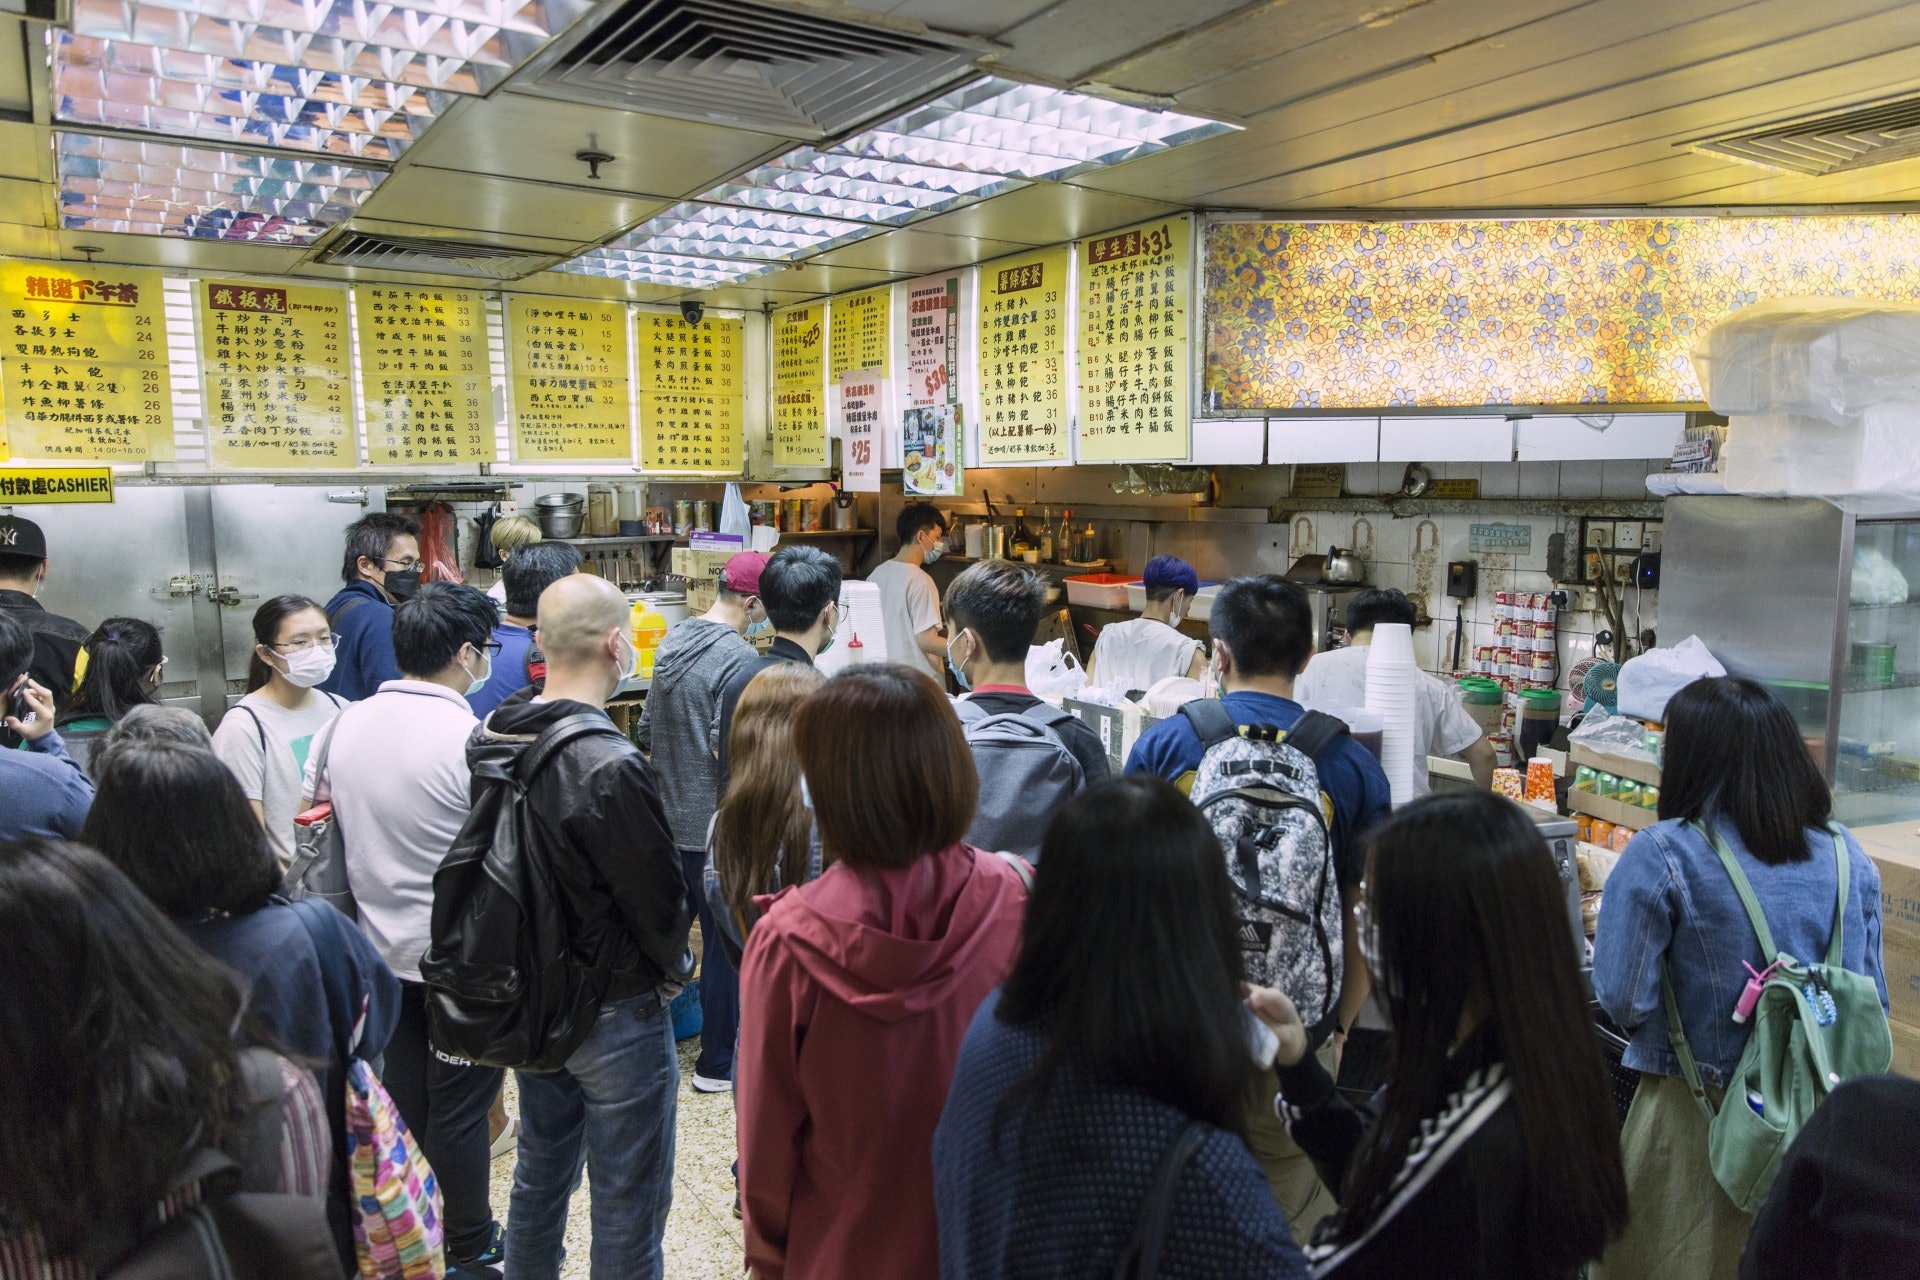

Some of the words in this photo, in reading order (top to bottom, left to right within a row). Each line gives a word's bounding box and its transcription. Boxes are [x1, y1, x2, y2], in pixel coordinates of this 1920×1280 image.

[1095, 233, 1137, 260] 學生餐
[1141, 224, 1173, 257] $31
[999, 265, 1041, 291] 薯條套餐
[26, 276, 139, 304] 精選下午茶
[214, 288, 286, 312] 鐵板燒
[456, 293, 469, 302] 33
[983, 305, 989, 313] A
[994, 296, 1028, 312] 炸豬扒
[1045, 291, 1057, 303] 33
[373, 303, 444, 314] 西冷牛扒飯
[457, 306, 469, 315] 33
[11, 309, 81, 322] 西多士
[135, 315, 152, 326] 24
[215, 312, 294, 326] 干炒牛河
[458, 319, 471, 327] 33
[601, 314, 612, 322] 50
[983, 321, 989, 329] B
[1044, 308, 1057, 320] 33
[720, 322, 731, 332] 33
[1044, 324, 1056, 337] 36
[14, 325, 77, 338] 各款多士
[136, 331, 153, 342] 24
[459, 335, 472, 343] 36
[601, 330, 612, 339] 15
[653, 331, 713, 344] 火腿煎蛋飯
[720, 335, 731, 345] 30
[802, 322, 821, 349] $25
[461, 350, 473, 358] 36
[601, 344, 612, 353] 12
[720, 349, 731, 359] 30
[982, 351, 988, 359] D
[1044, 340, 1056, 351] 31
[139, 349, 155, 360] 26
[325, 356, 338, 364] 42
[461, 363, 474, 371] 33
[585, 364, 596, 373] 10
[598, 365, 609, 373] 15
[653, 359, 713, 372] 餐肉煎蛋飯
[720, 363, 731, 372] 30
[983, 368, 989, 377] E
[1045, 357, 1057, 369] 33
[1104, 360, 1174, 379] 腸仔牛扒飯
[20, 363, 104, 379] 牛扒飽
[142, 370, 159, 381] 26
[602, 380, 613, 388] 32
[721, 378, 732, 387] 36
[925, 363, 949, 397] $38
[984, 383, 990, 391] F
[1045, 373, 1058, 385] 33
[143, 383, 160, 394] 26
[465, 382, 477, 391] 37
[466, 398, 479, 407] 36
[603, 396, 614, 405] 32
[720, 397, 730, 405] 33
[985, 398, 991, 406] G
[1046, 389, 1058, 400] 36
[22, 396, 106, 410] 炸魚柳薯條
[144, 400, 161, 411] 26
[328, 405, 341, 413] 42
[145, 414, 162, 425] 28
[467, 410, 480, 419] 33
[985, 414, 991, 422] H
[1046, 407, 1058, 419] 31
[1089, 413, 1104, 422] B10
[222, 425, 313, 436] 五香肉丁炒飯
[468, 422, 481, 431] 33
[1089, 427, 1104, 435] B11
[469, 435, 481, 444] 33
[720, 435, 730, 443] 33
[469, 447, 482, 456] 34
[851, 439, 870, 466] $25
[47, 477, 109, 493] CASHIER
